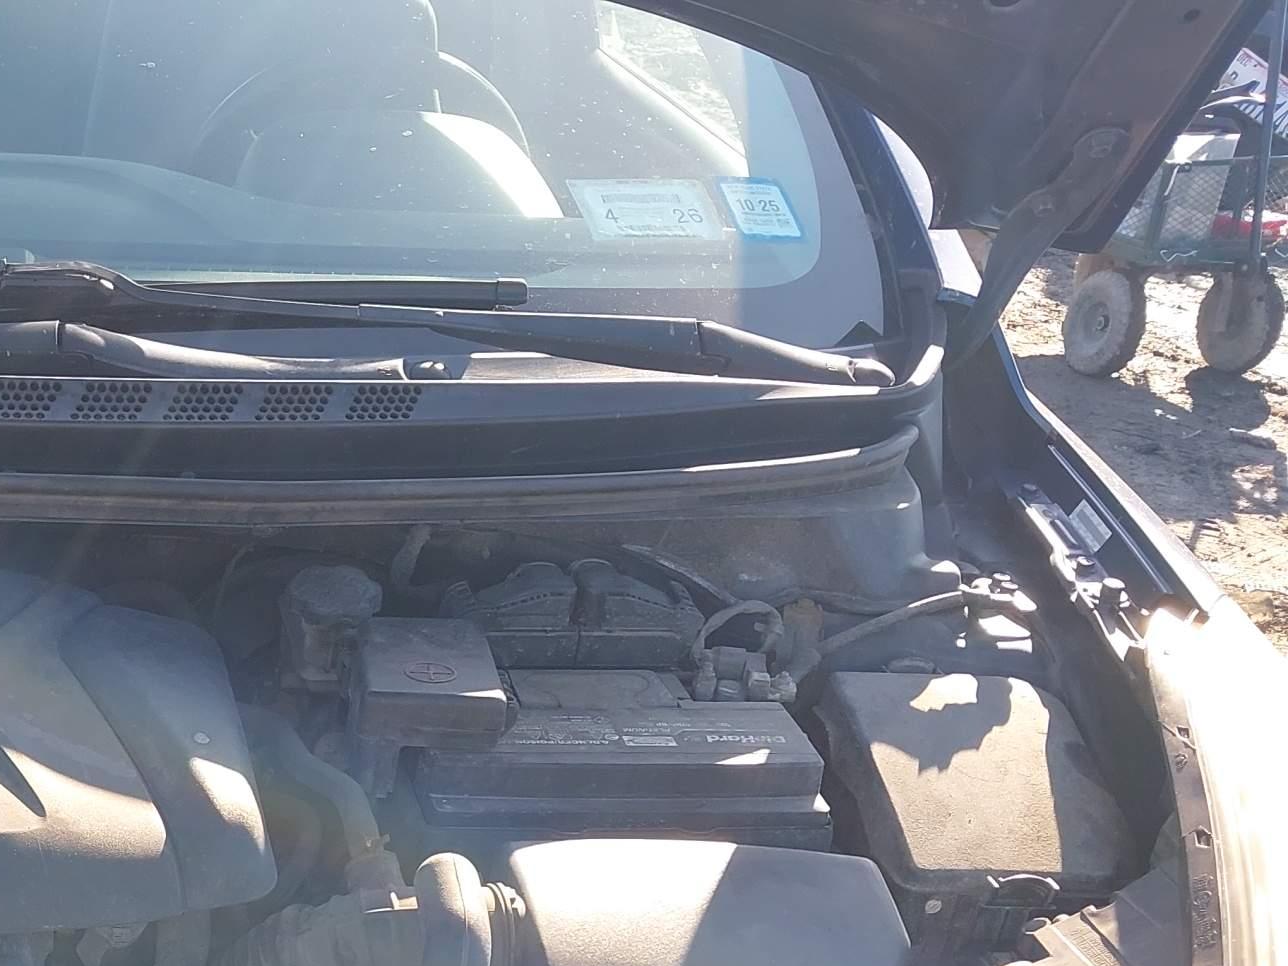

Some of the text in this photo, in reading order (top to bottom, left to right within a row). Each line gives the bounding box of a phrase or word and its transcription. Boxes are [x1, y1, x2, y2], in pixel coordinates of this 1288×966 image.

[736, 199, 780, 213] 10 25
[605, 208, 704, 224] 4 26
